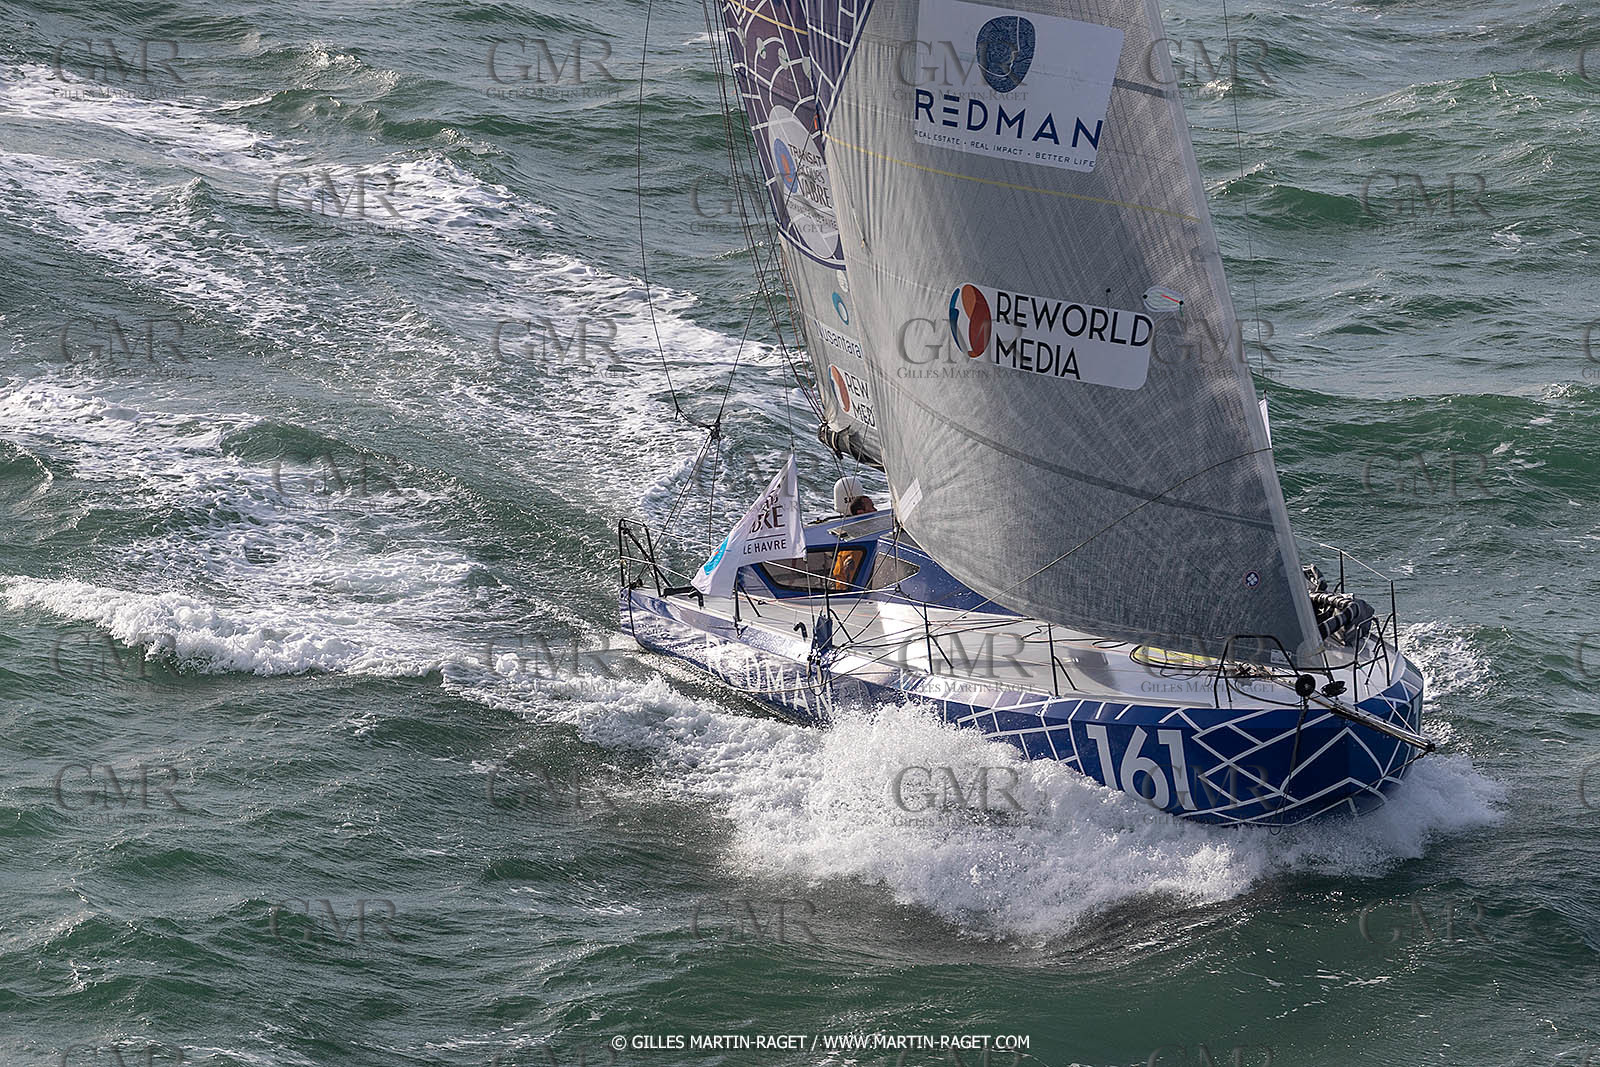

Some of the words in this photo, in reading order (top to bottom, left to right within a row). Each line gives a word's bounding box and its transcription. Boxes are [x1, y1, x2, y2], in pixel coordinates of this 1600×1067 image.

[915, 88, 1104, 151] REDMAN
[914, 129, 932, 141] REAL
[933, 134, 960, 146] ESTATE
[970, 141, 989, 151] REAL
[993, 145, 1024, 156] IMPACT
[1035, 152, 1071, 164] BETTER
[1073, 158, 1095, 168] LIFE
[996, 291, 1153, 347] REWORLD
[996, 333, 1081, 380] MEDIA
[743, 544, 752, 555] LE
[754, 538, 787, 554] HAVRE
[1085, 723, 1198, 811] 161
